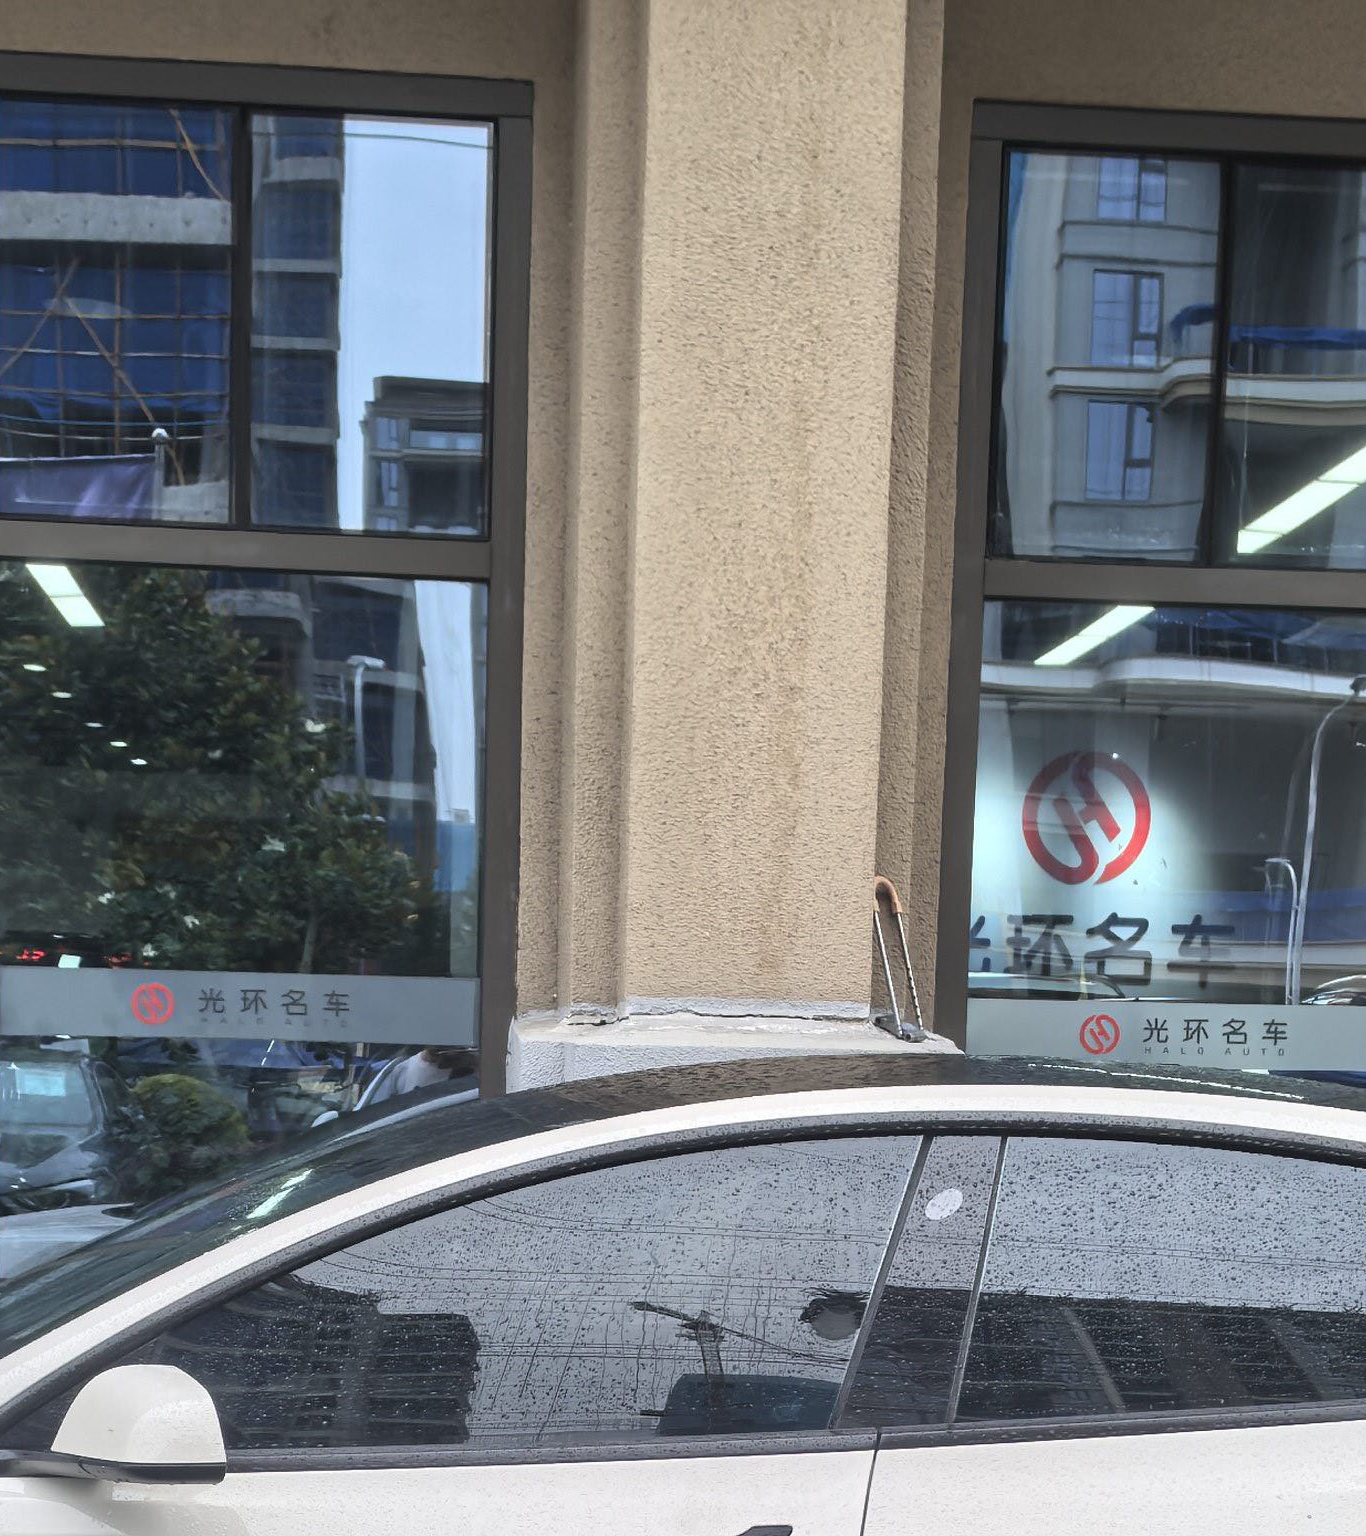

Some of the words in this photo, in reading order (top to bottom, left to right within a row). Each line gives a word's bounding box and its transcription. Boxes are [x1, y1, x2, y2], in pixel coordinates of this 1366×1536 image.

[198, 988, 350, 1017] 光环名车
[1143, 1018, 1288, 1046] 光环名车
[1145, 1047, 1204, 1056] HALO
[1225, 1047, 1285, 1057] AUTO
